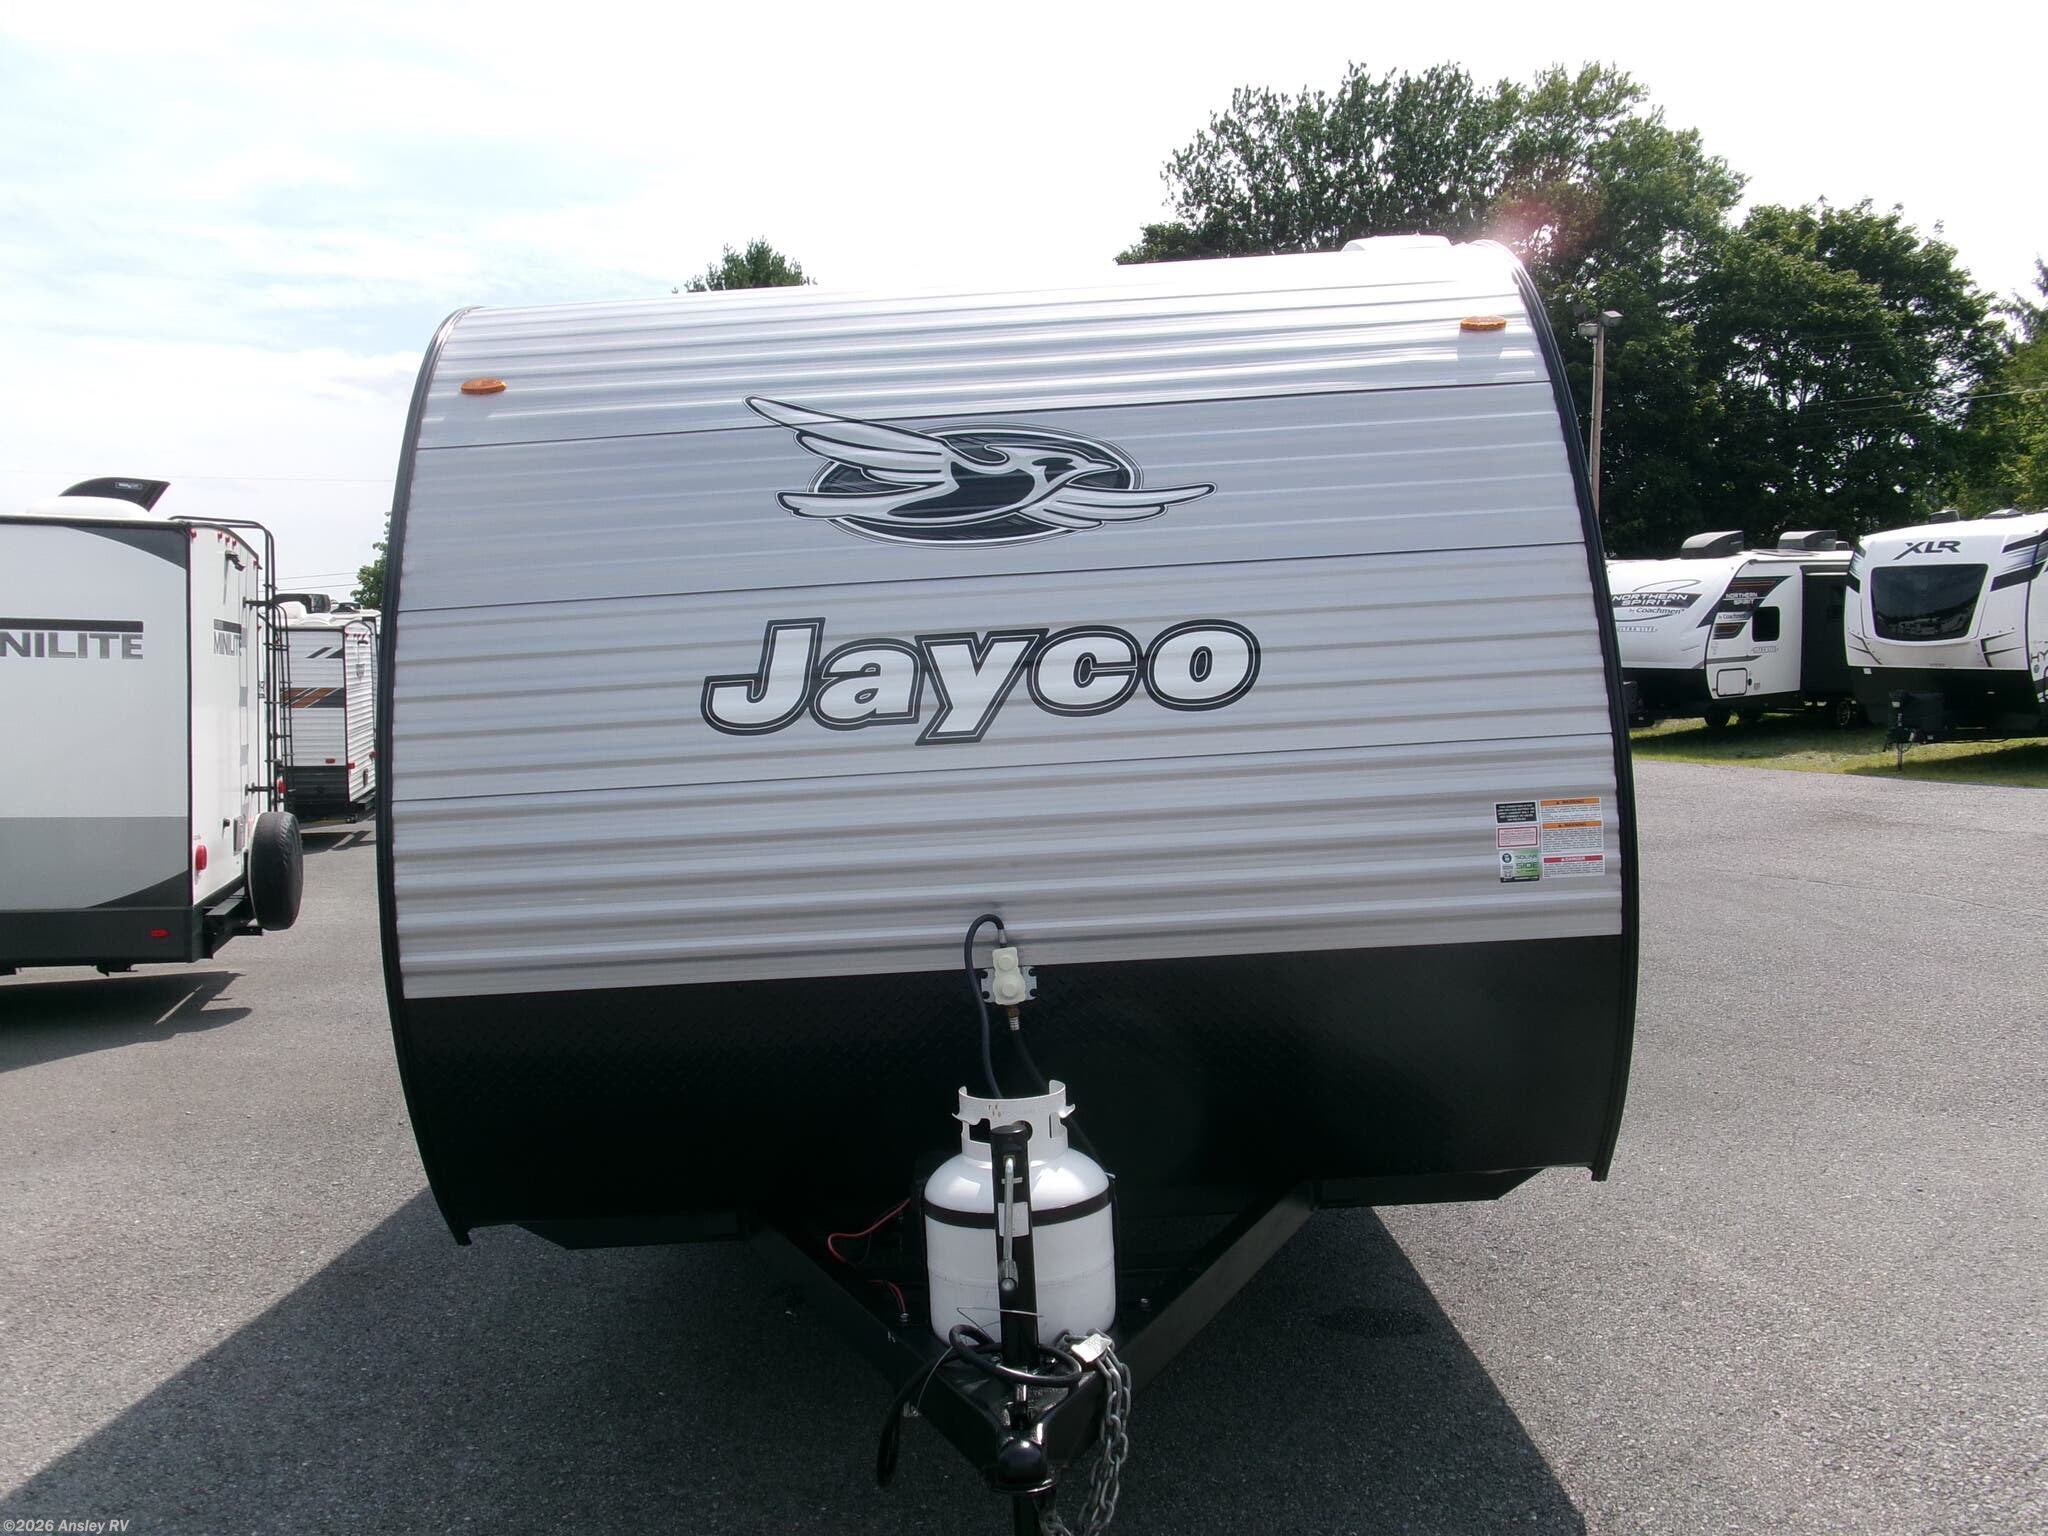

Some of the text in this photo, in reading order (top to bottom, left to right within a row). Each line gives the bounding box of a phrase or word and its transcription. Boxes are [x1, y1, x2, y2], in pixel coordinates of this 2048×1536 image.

[1892, 540, 1962, 561] XLR
[1612, 593, 1689, 601] NORTHERN
[700, 617, 1262, 746] Jayco
